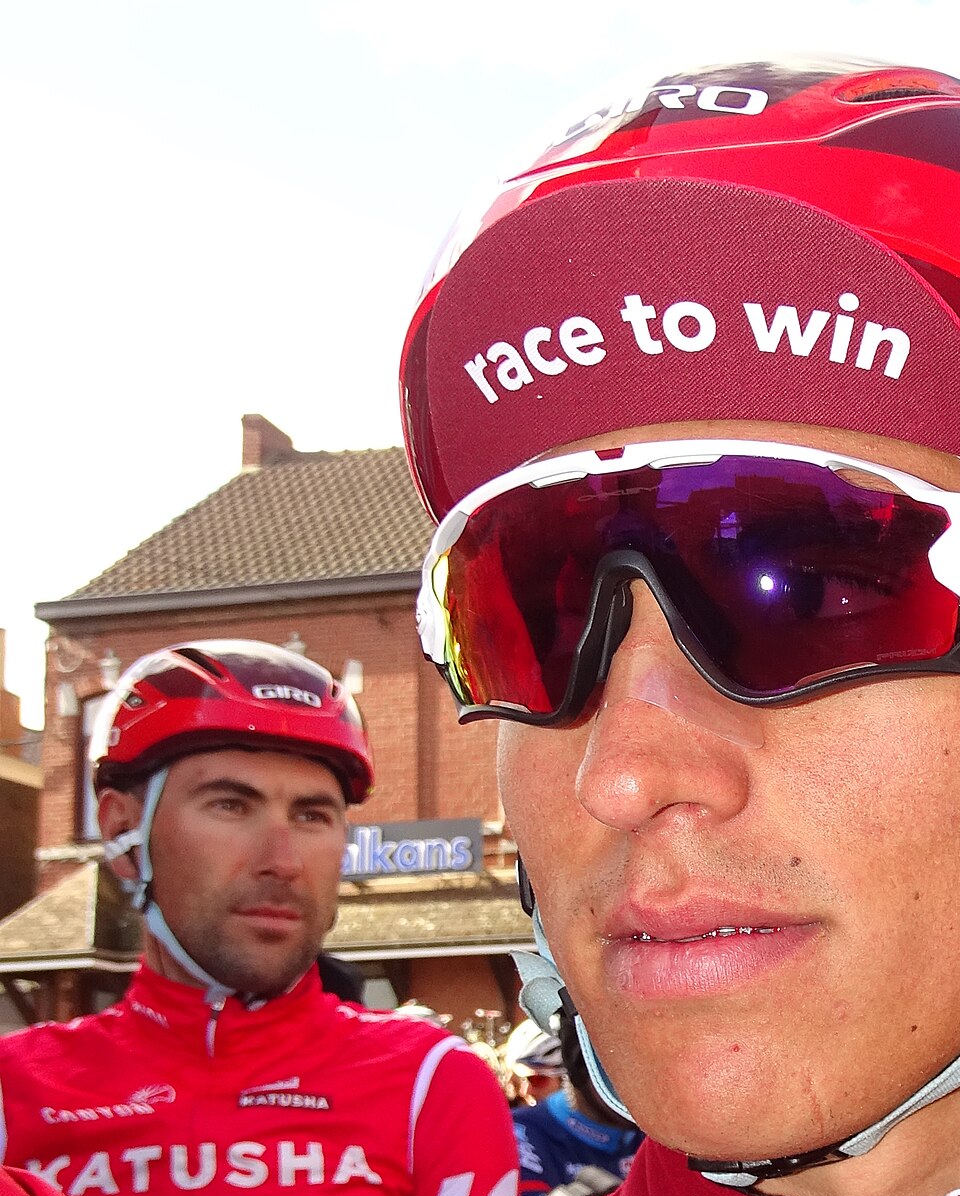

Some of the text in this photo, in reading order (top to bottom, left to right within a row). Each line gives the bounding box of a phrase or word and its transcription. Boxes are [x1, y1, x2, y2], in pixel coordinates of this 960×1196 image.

[463, 292, 911, 404] race to win
[252, 684, 322, 708] GIRO
[239, 1092, 329, 1110] KATUSHA
[25, 1141, 382, 1196] KATUSHA
